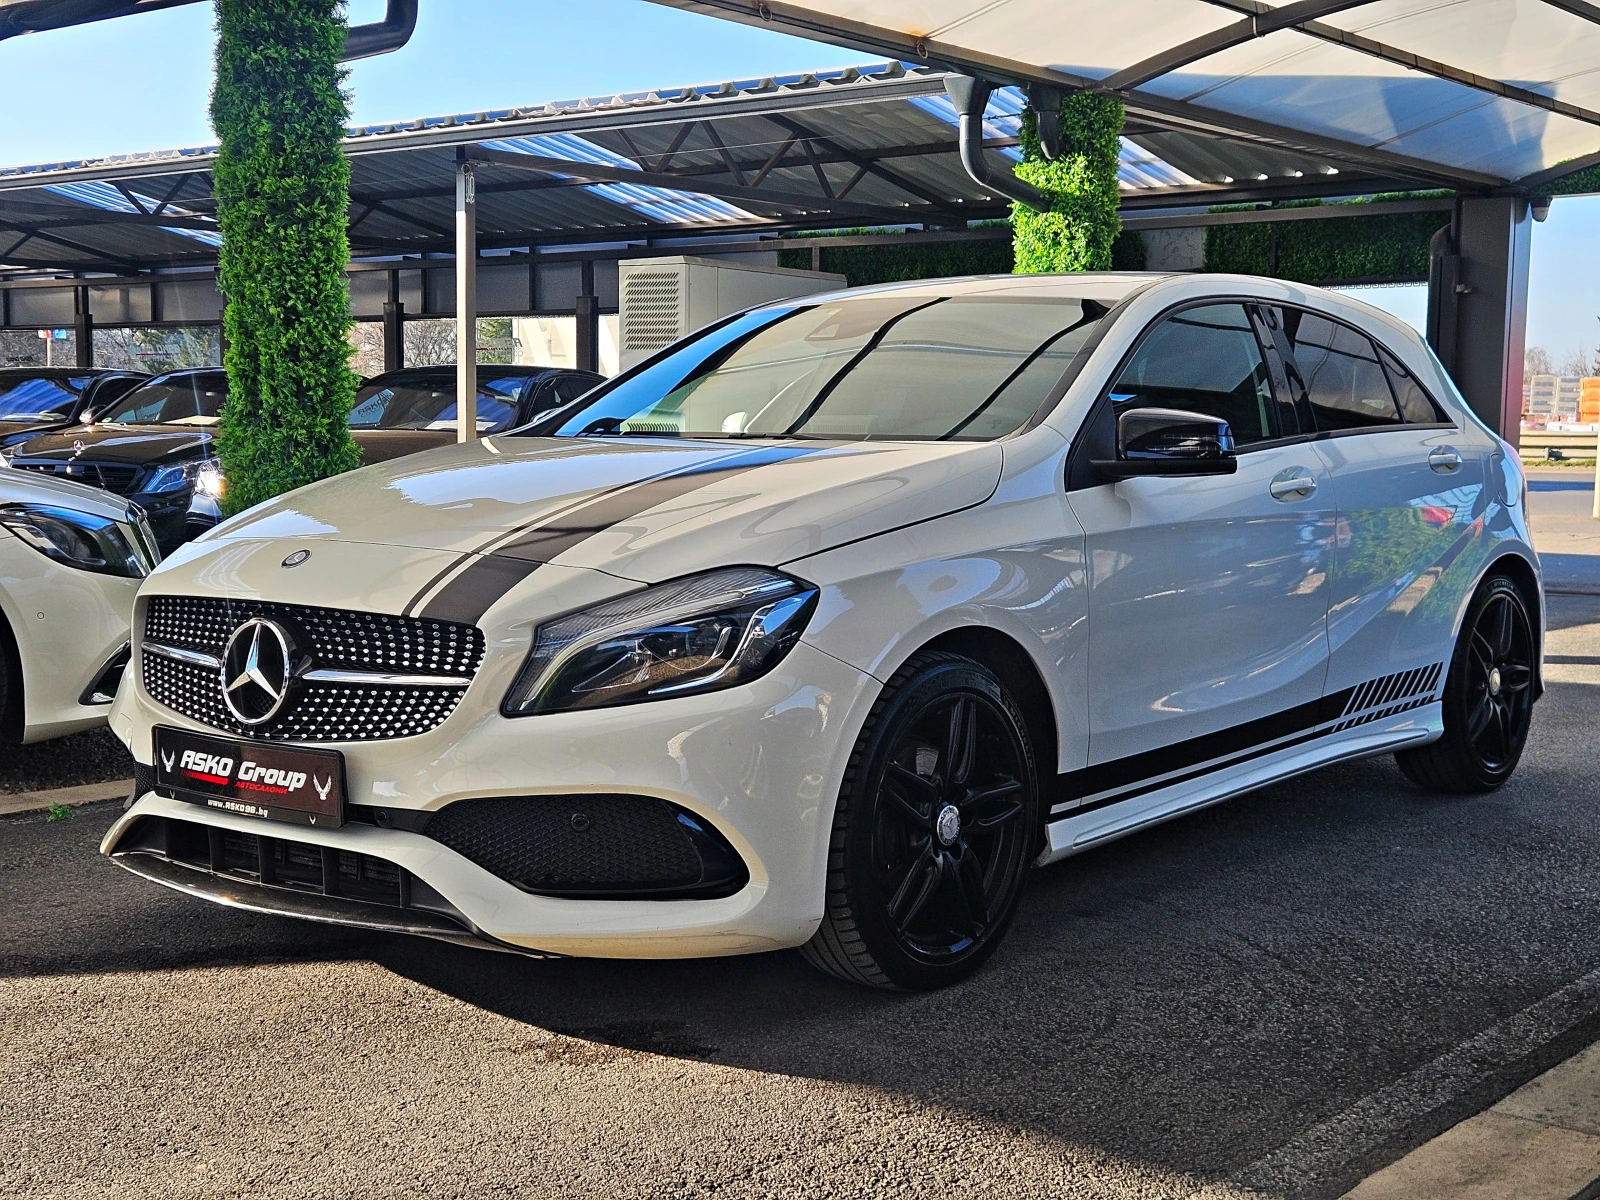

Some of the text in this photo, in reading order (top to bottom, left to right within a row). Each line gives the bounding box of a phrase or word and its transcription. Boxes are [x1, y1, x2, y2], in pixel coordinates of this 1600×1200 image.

[180, 750, 307, 791] ASKO Group
[235, 781, 288, 795] АВТОСАЛОНИ
[207, 799, 269, 817] www.ASKO98.bg
